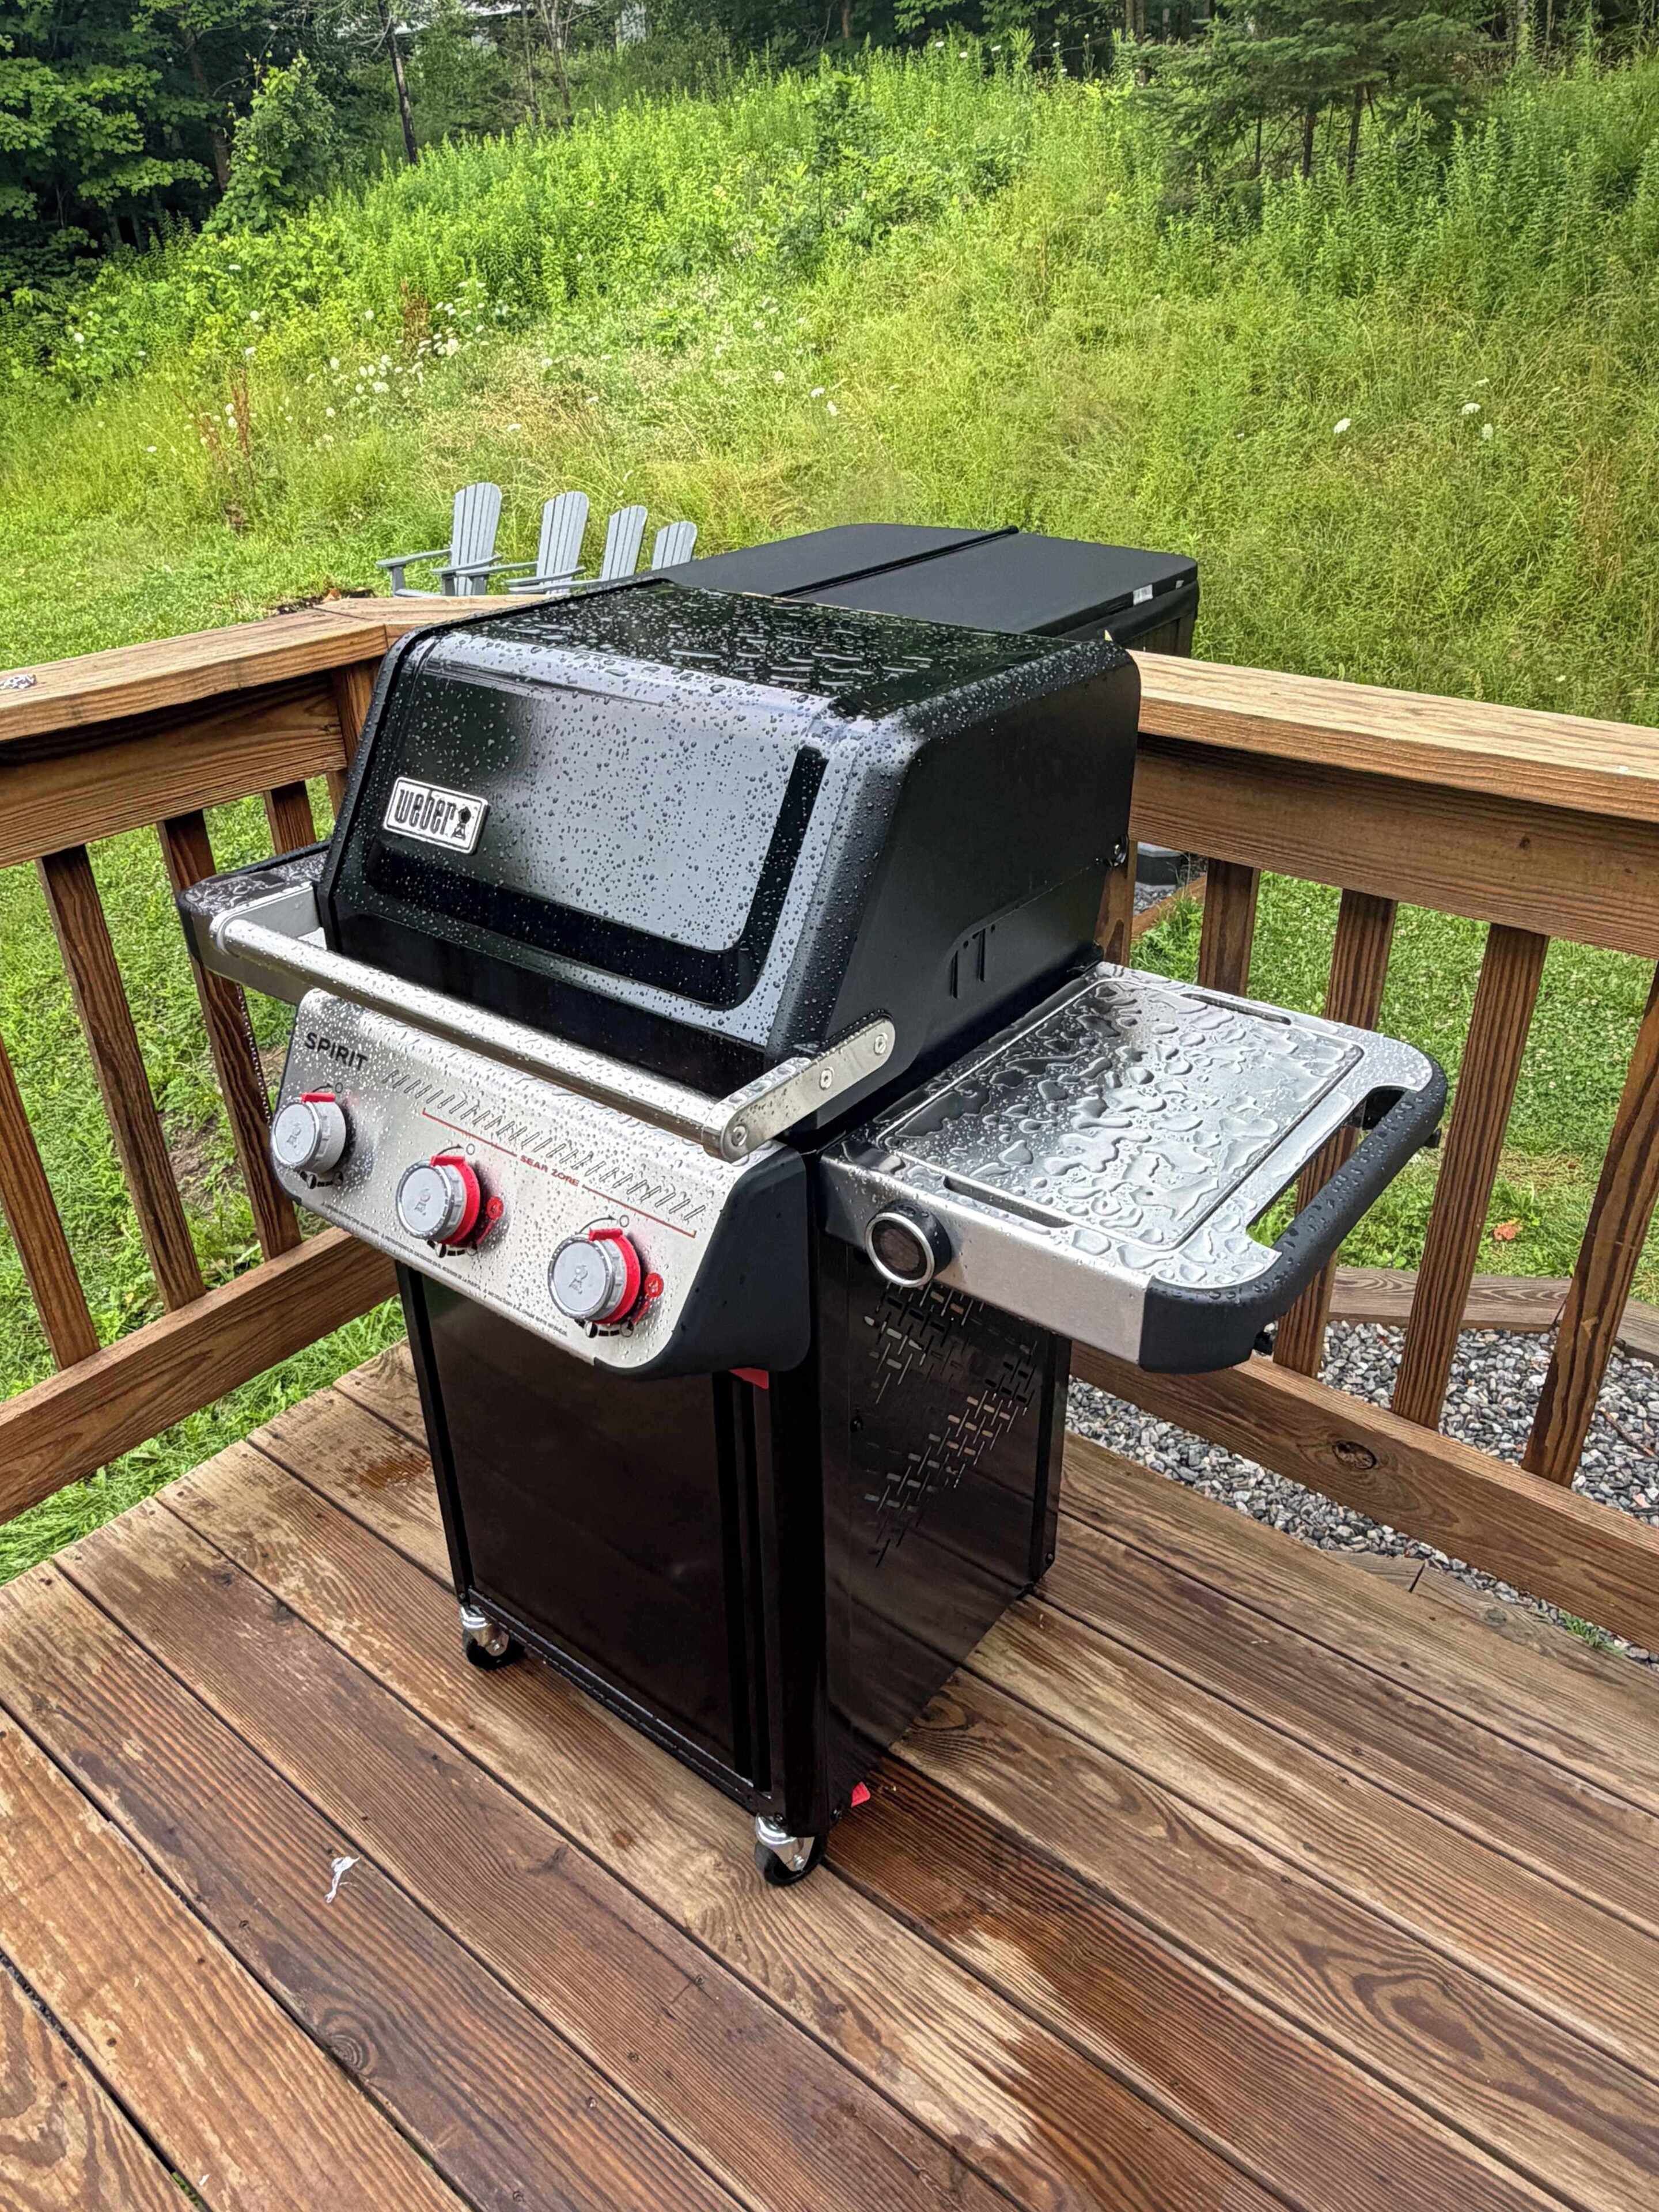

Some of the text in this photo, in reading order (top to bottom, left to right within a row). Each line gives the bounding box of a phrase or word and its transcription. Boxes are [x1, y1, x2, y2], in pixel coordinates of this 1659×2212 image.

[394, 789, 457, 835] weber
[304, 1031, 368, 1071] SPIRIT
[520, 1154, 579, 1187] SEAR ZONE
